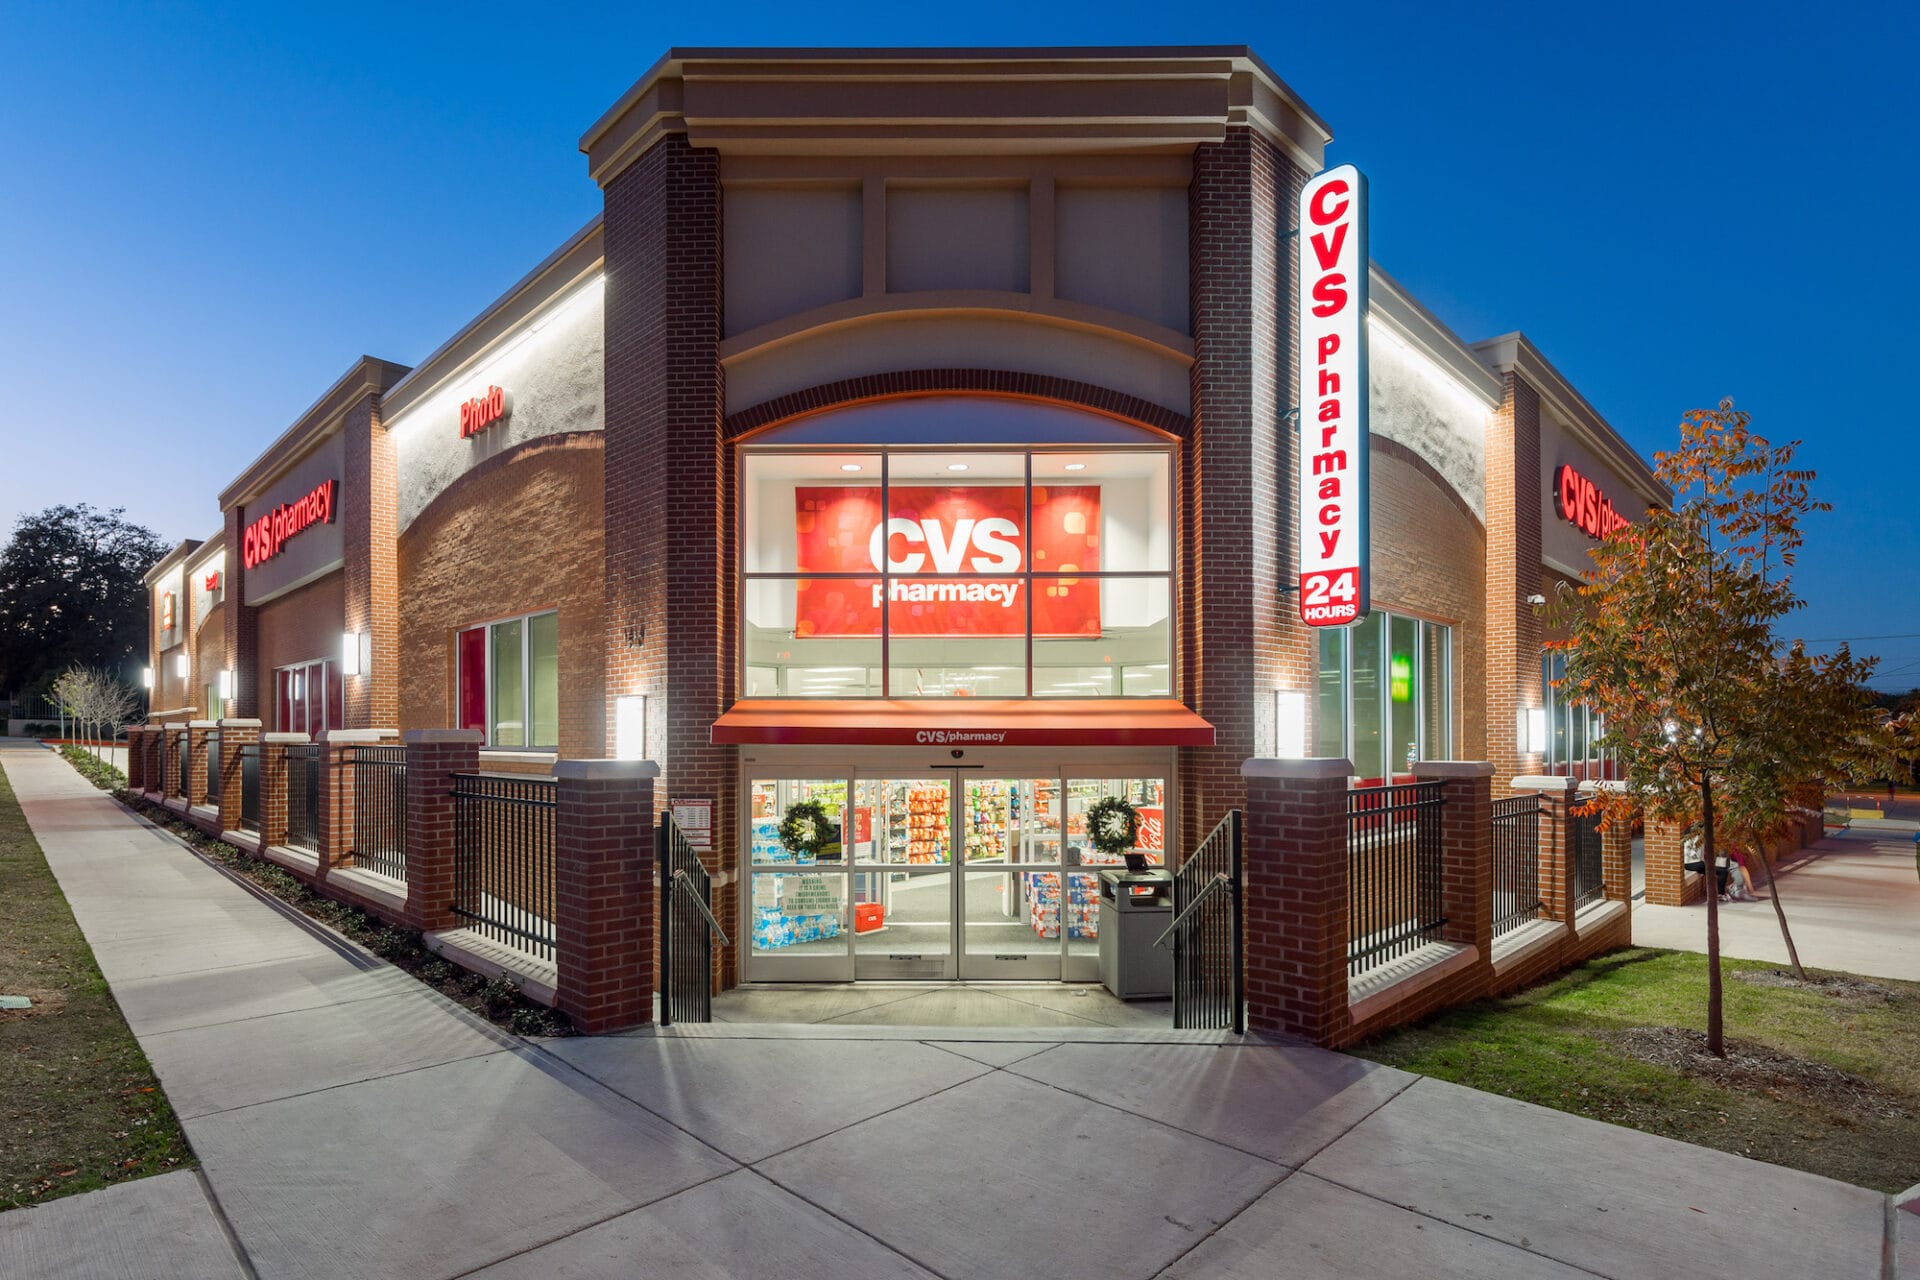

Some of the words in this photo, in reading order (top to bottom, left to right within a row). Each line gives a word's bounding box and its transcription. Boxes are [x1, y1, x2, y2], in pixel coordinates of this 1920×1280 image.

[1309, 179, 1349, 318] CVS
[460, 385, 504, 439] Photo
[1313, 333, 1347, 559] pharmacy
[244, 479, 332, 570] CVS/pharmacy
[869, 517, 1022, 574] CVS
[872, 578, 1019, 608] pharmacy
[1304, 571, 1356, 605] 24
[1304, 603, 1356, 620] HOURS
[916, 730, 1006, 743] CVS/pharmacy
